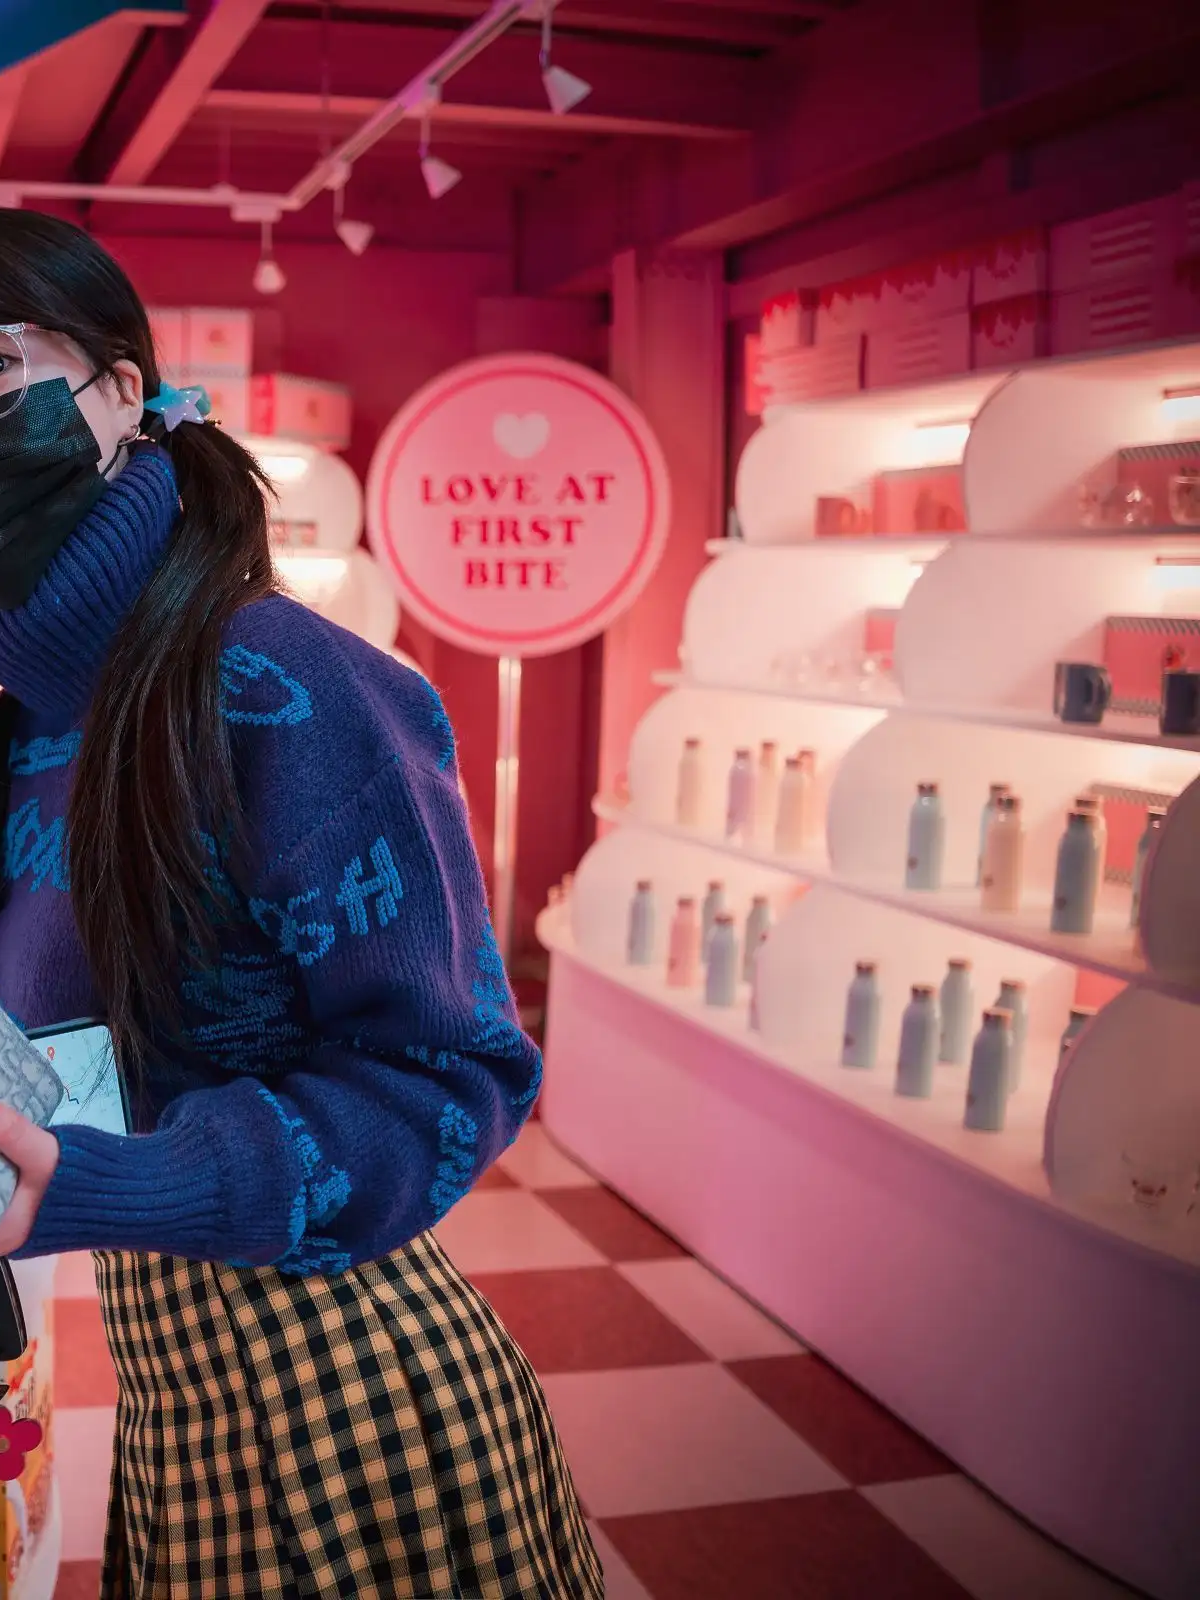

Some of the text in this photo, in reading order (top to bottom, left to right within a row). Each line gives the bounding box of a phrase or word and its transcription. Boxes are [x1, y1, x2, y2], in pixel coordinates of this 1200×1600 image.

[420, 472, 616, 505] LOVE AT
[452, 517, 584, 546] FIRST
[465, 559, 569, 589] BITE
